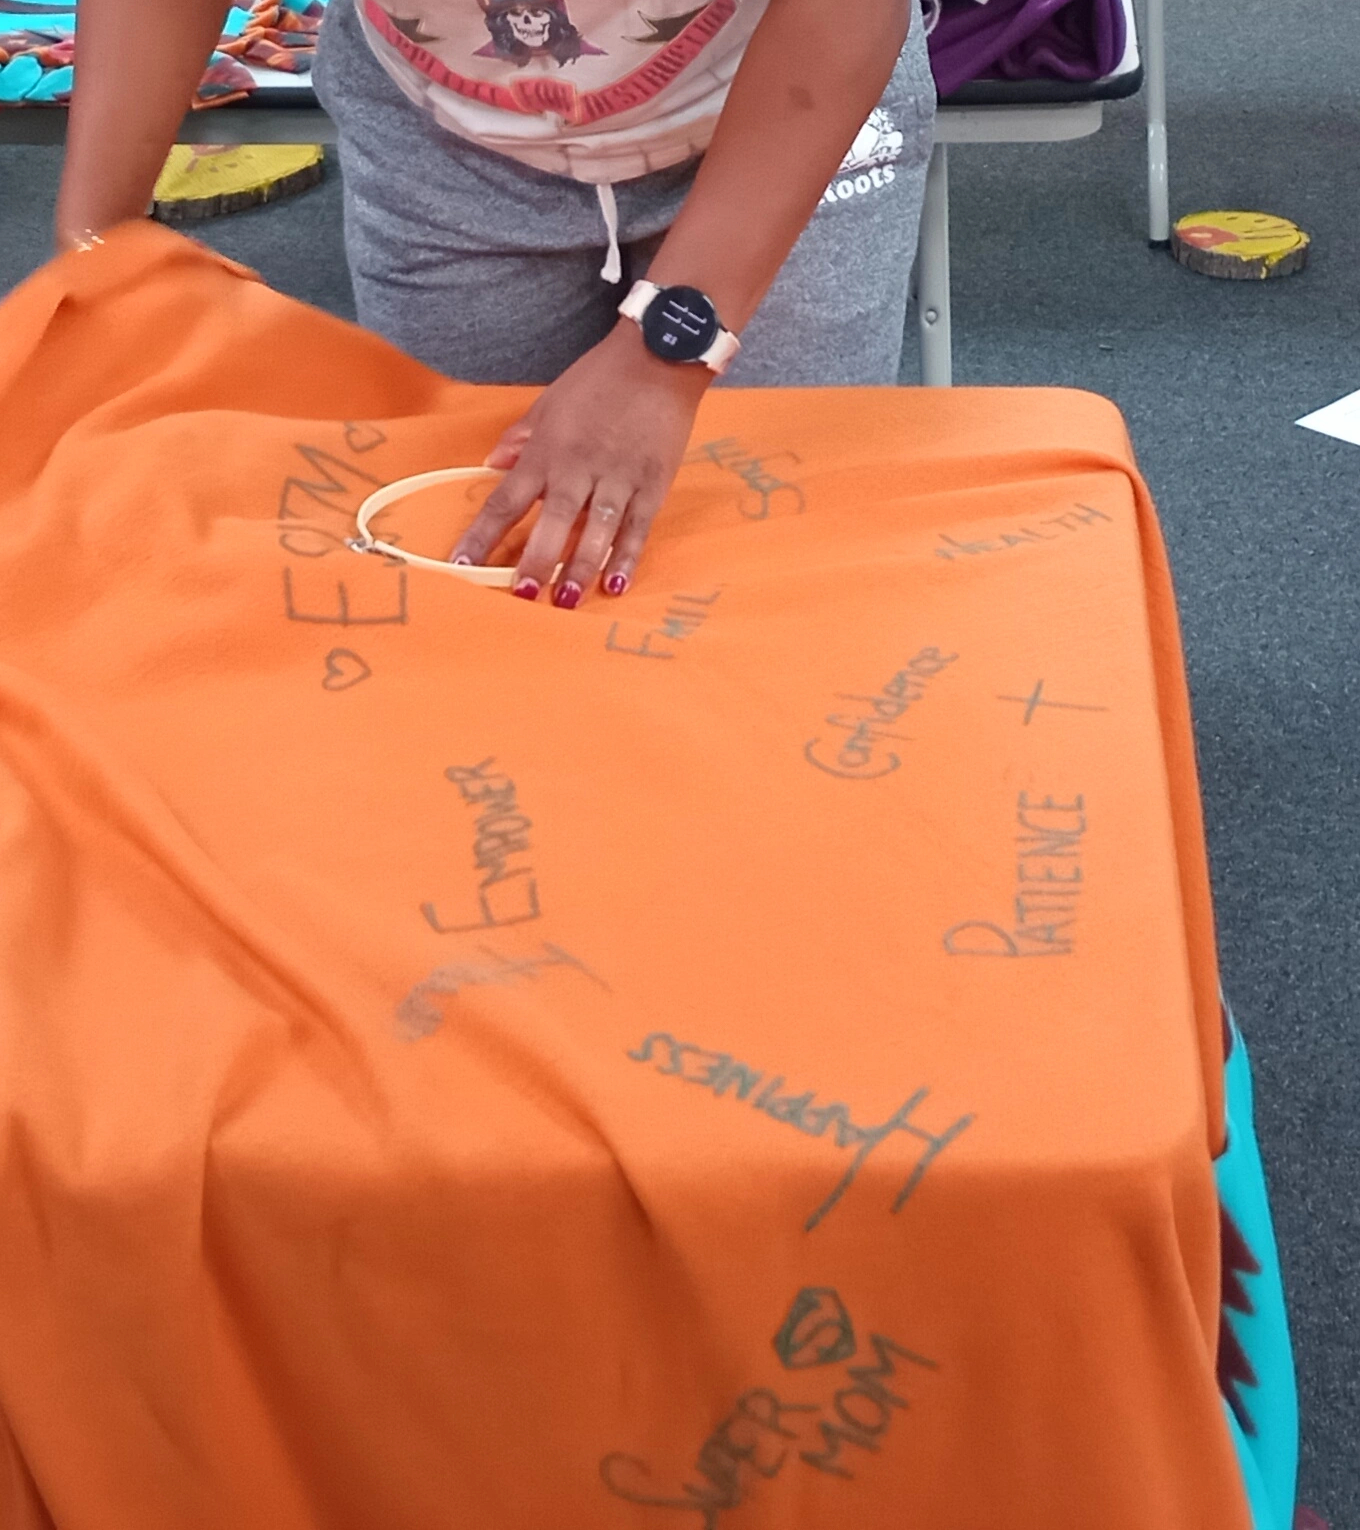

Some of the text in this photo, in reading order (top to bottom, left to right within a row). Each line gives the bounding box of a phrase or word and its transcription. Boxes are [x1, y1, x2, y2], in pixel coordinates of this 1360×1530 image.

[419, 755, 543, 936] EMPOWER
[942, 789, 1088, 958] PATIENCE
[626, 1031, 979, 1233] HAPPINESS
[799, 1332, 940, 1482] MOM
